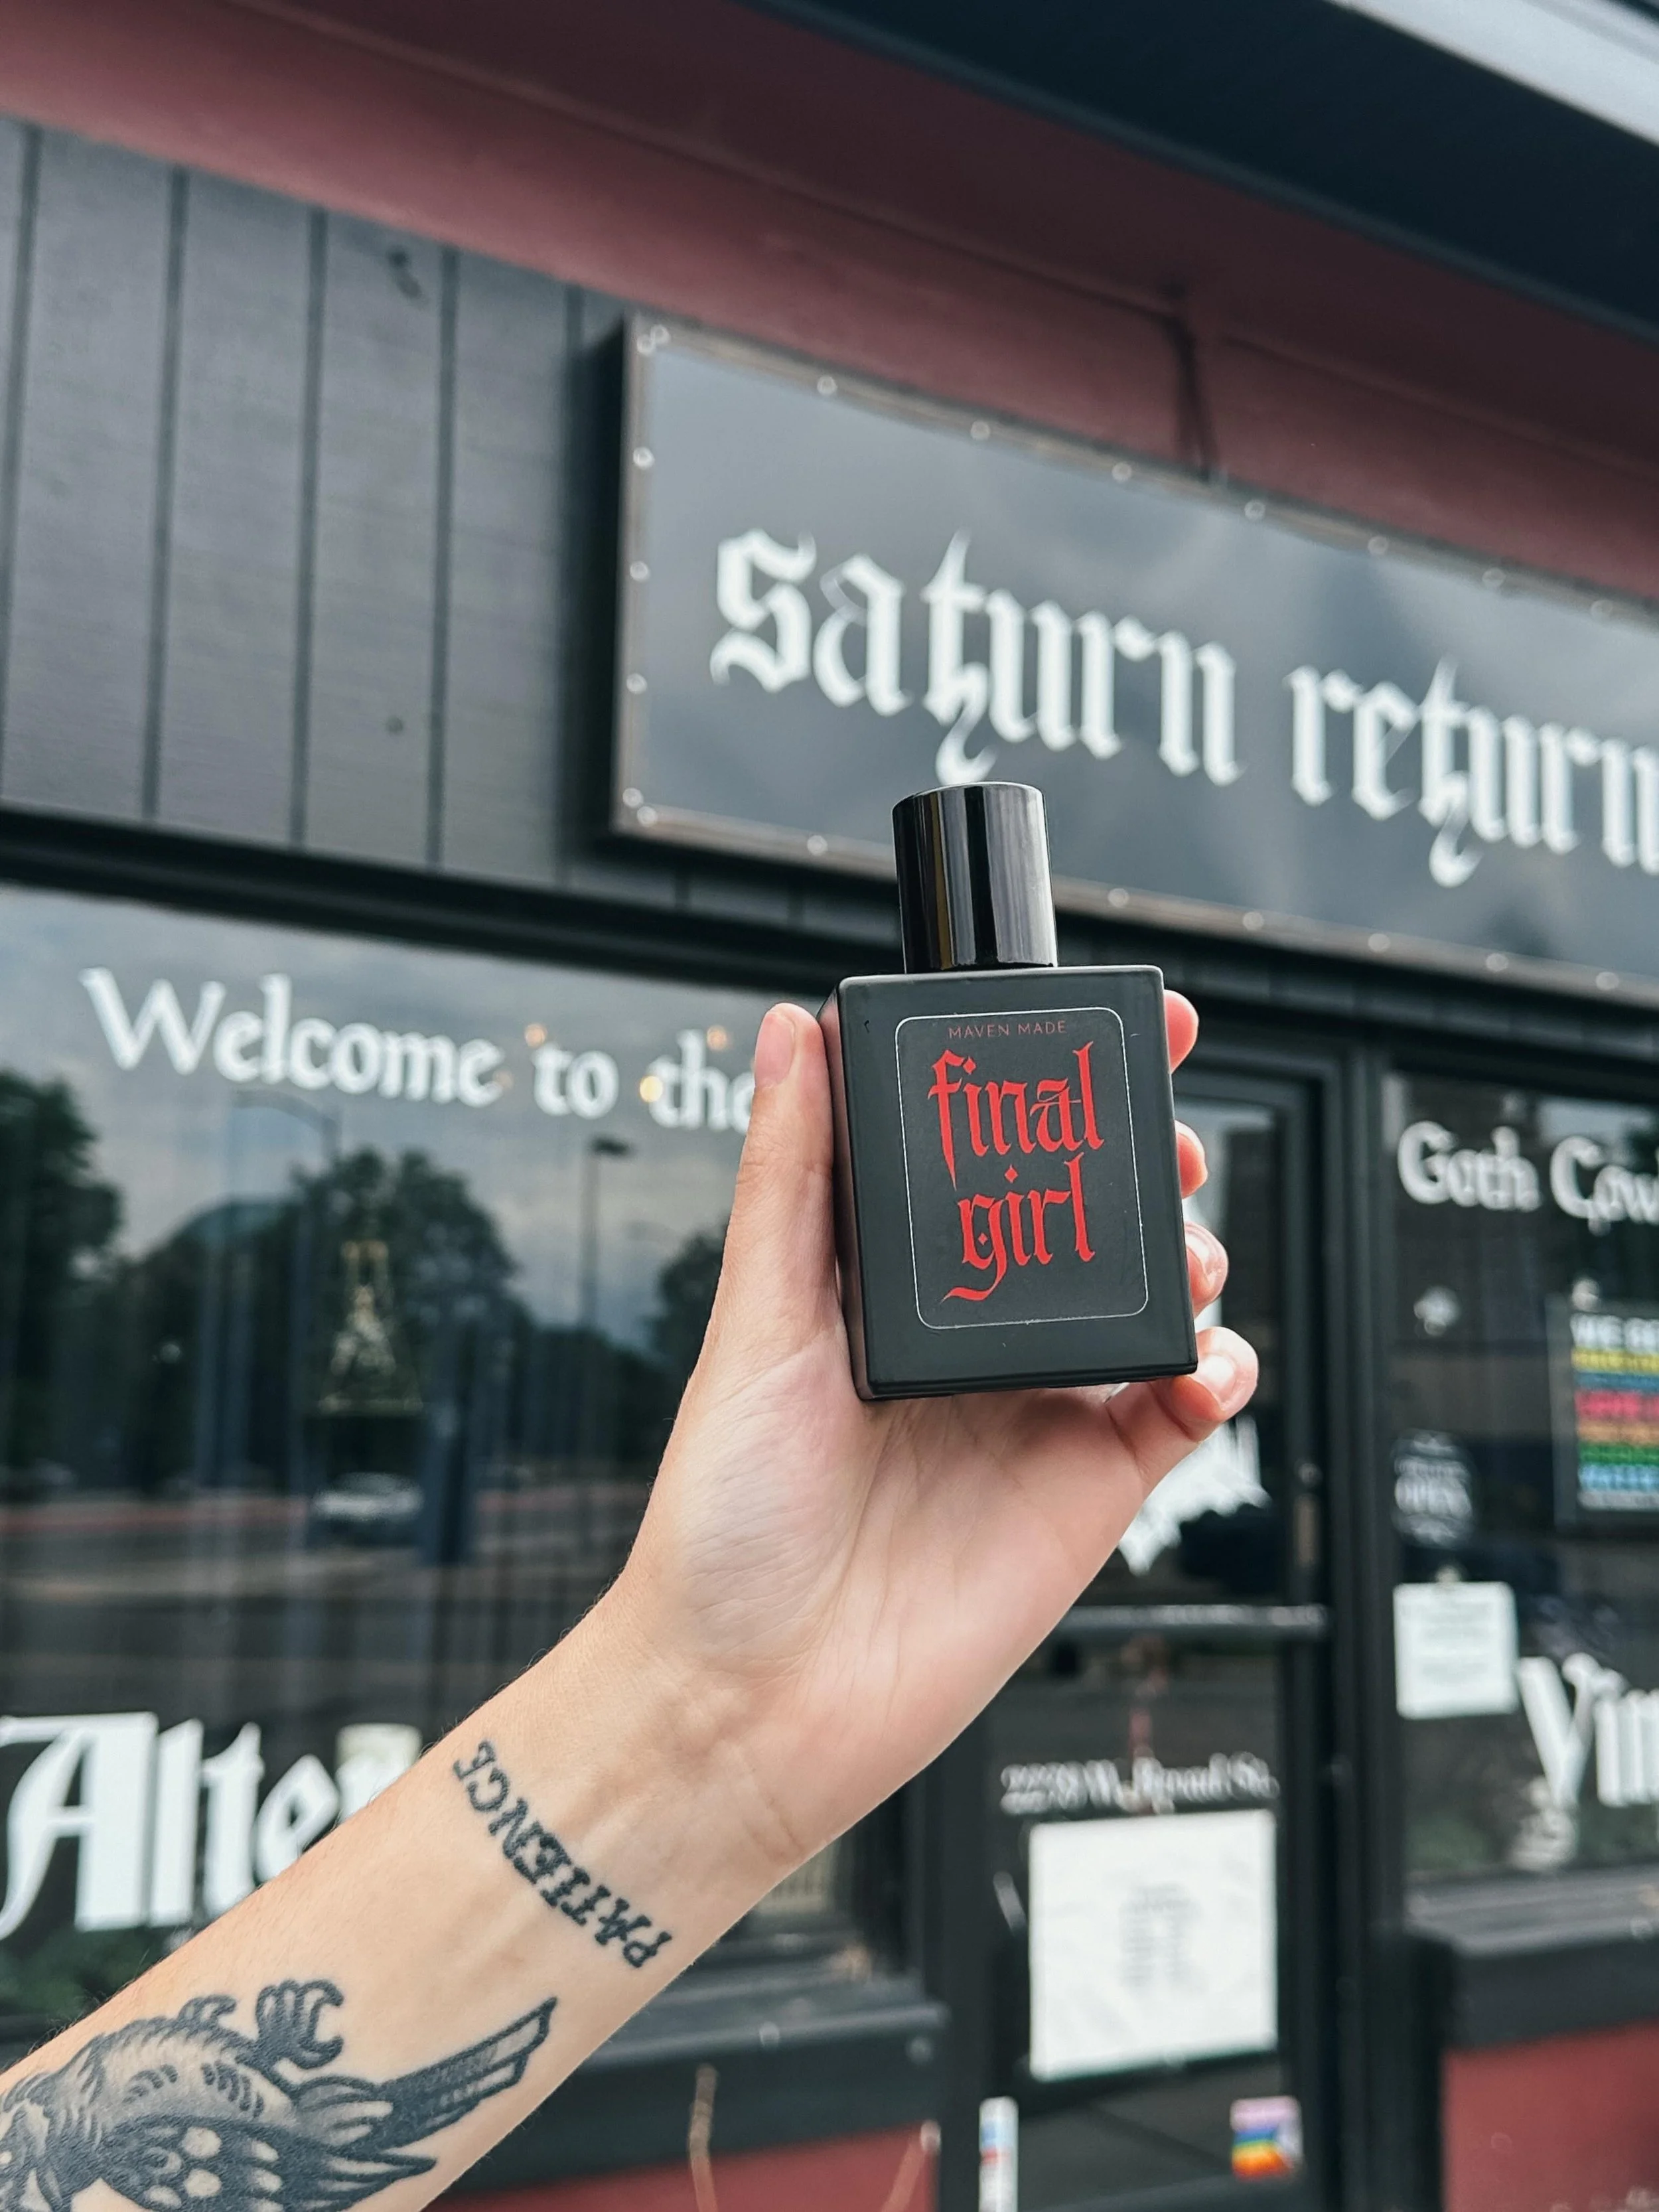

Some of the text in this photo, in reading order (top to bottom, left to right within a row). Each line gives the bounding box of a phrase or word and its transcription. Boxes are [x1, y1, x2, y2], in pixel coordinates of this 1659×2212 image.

[81, 968, 504, 1107] Welcome
[534, 1045, 618, 1119] to
[949, 1020, 1067, 1039] MAVEN MADE
[927, 1041, 1105, 1191] final
[1398, 1121, 1540, 1211] Goth
[940, 1152, 1096, 1303] girl
[452, 1739, 673, 1968] PATIENCE
